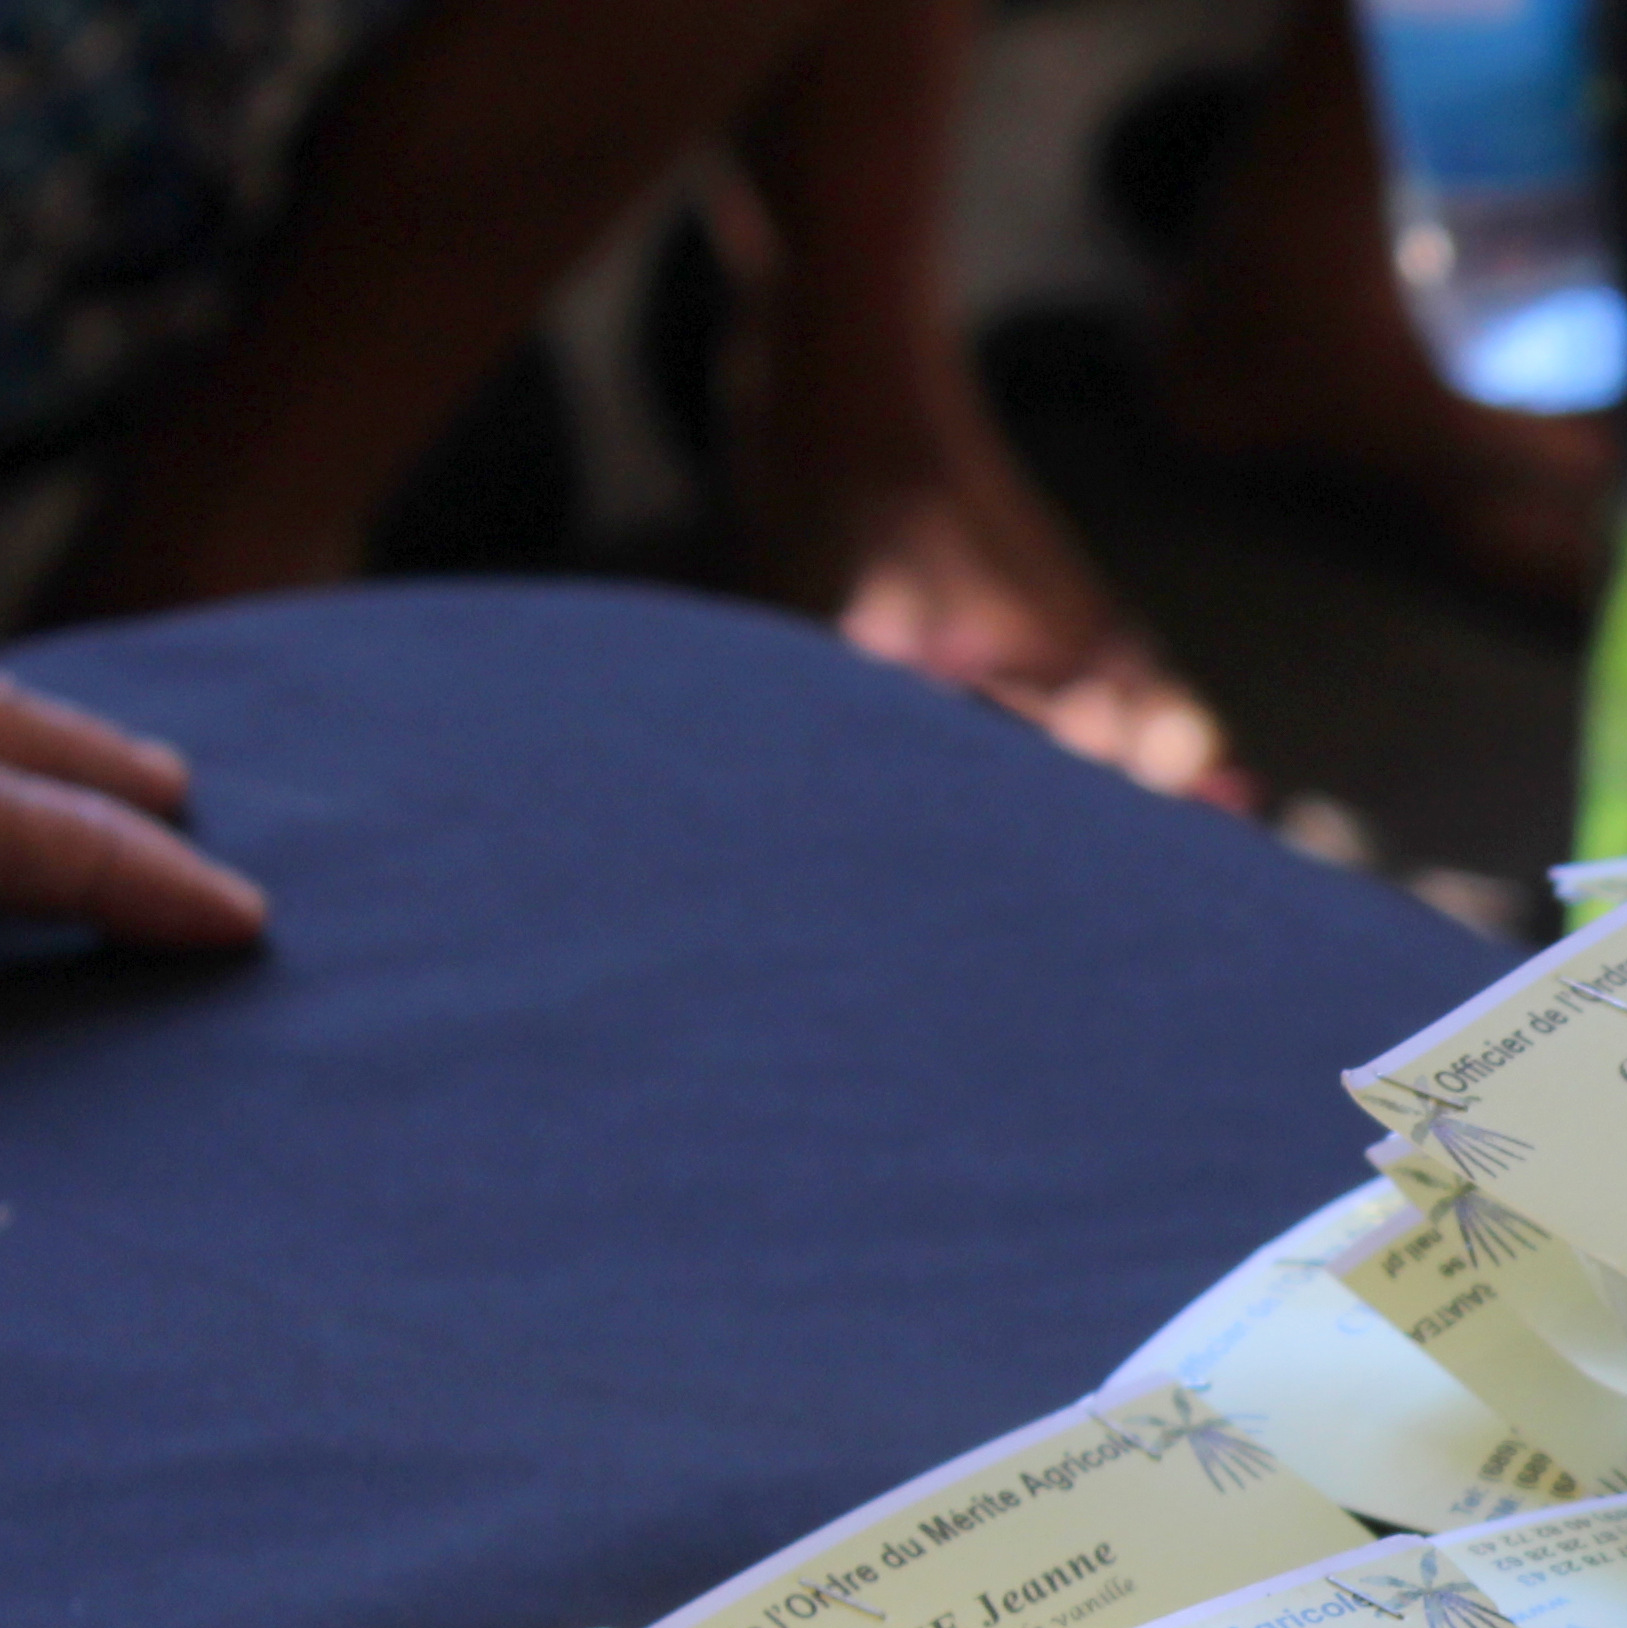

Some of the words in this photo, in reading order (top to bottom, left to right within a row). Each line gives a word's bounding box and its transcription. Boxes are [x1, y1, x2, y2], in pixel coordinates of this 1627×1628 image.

[1432, 1029, 1535, 1094] Officier
[1527, 1008, 1569, 1034] de
[879, 1539, 927, 1568] du
[917, 1490, 1022, 1544] Mérite
[1017, 1433, 1143, 1496] Agricole
[1468, 1542, 1497, 1554] 43
[1493, 1556, 1524, 1569] 62
[974, 1542, 1117, 1627] Jeanne
[1048, 1577, 1137, 1627] vanille
[1516, 1571, 1547, 1585] 43
